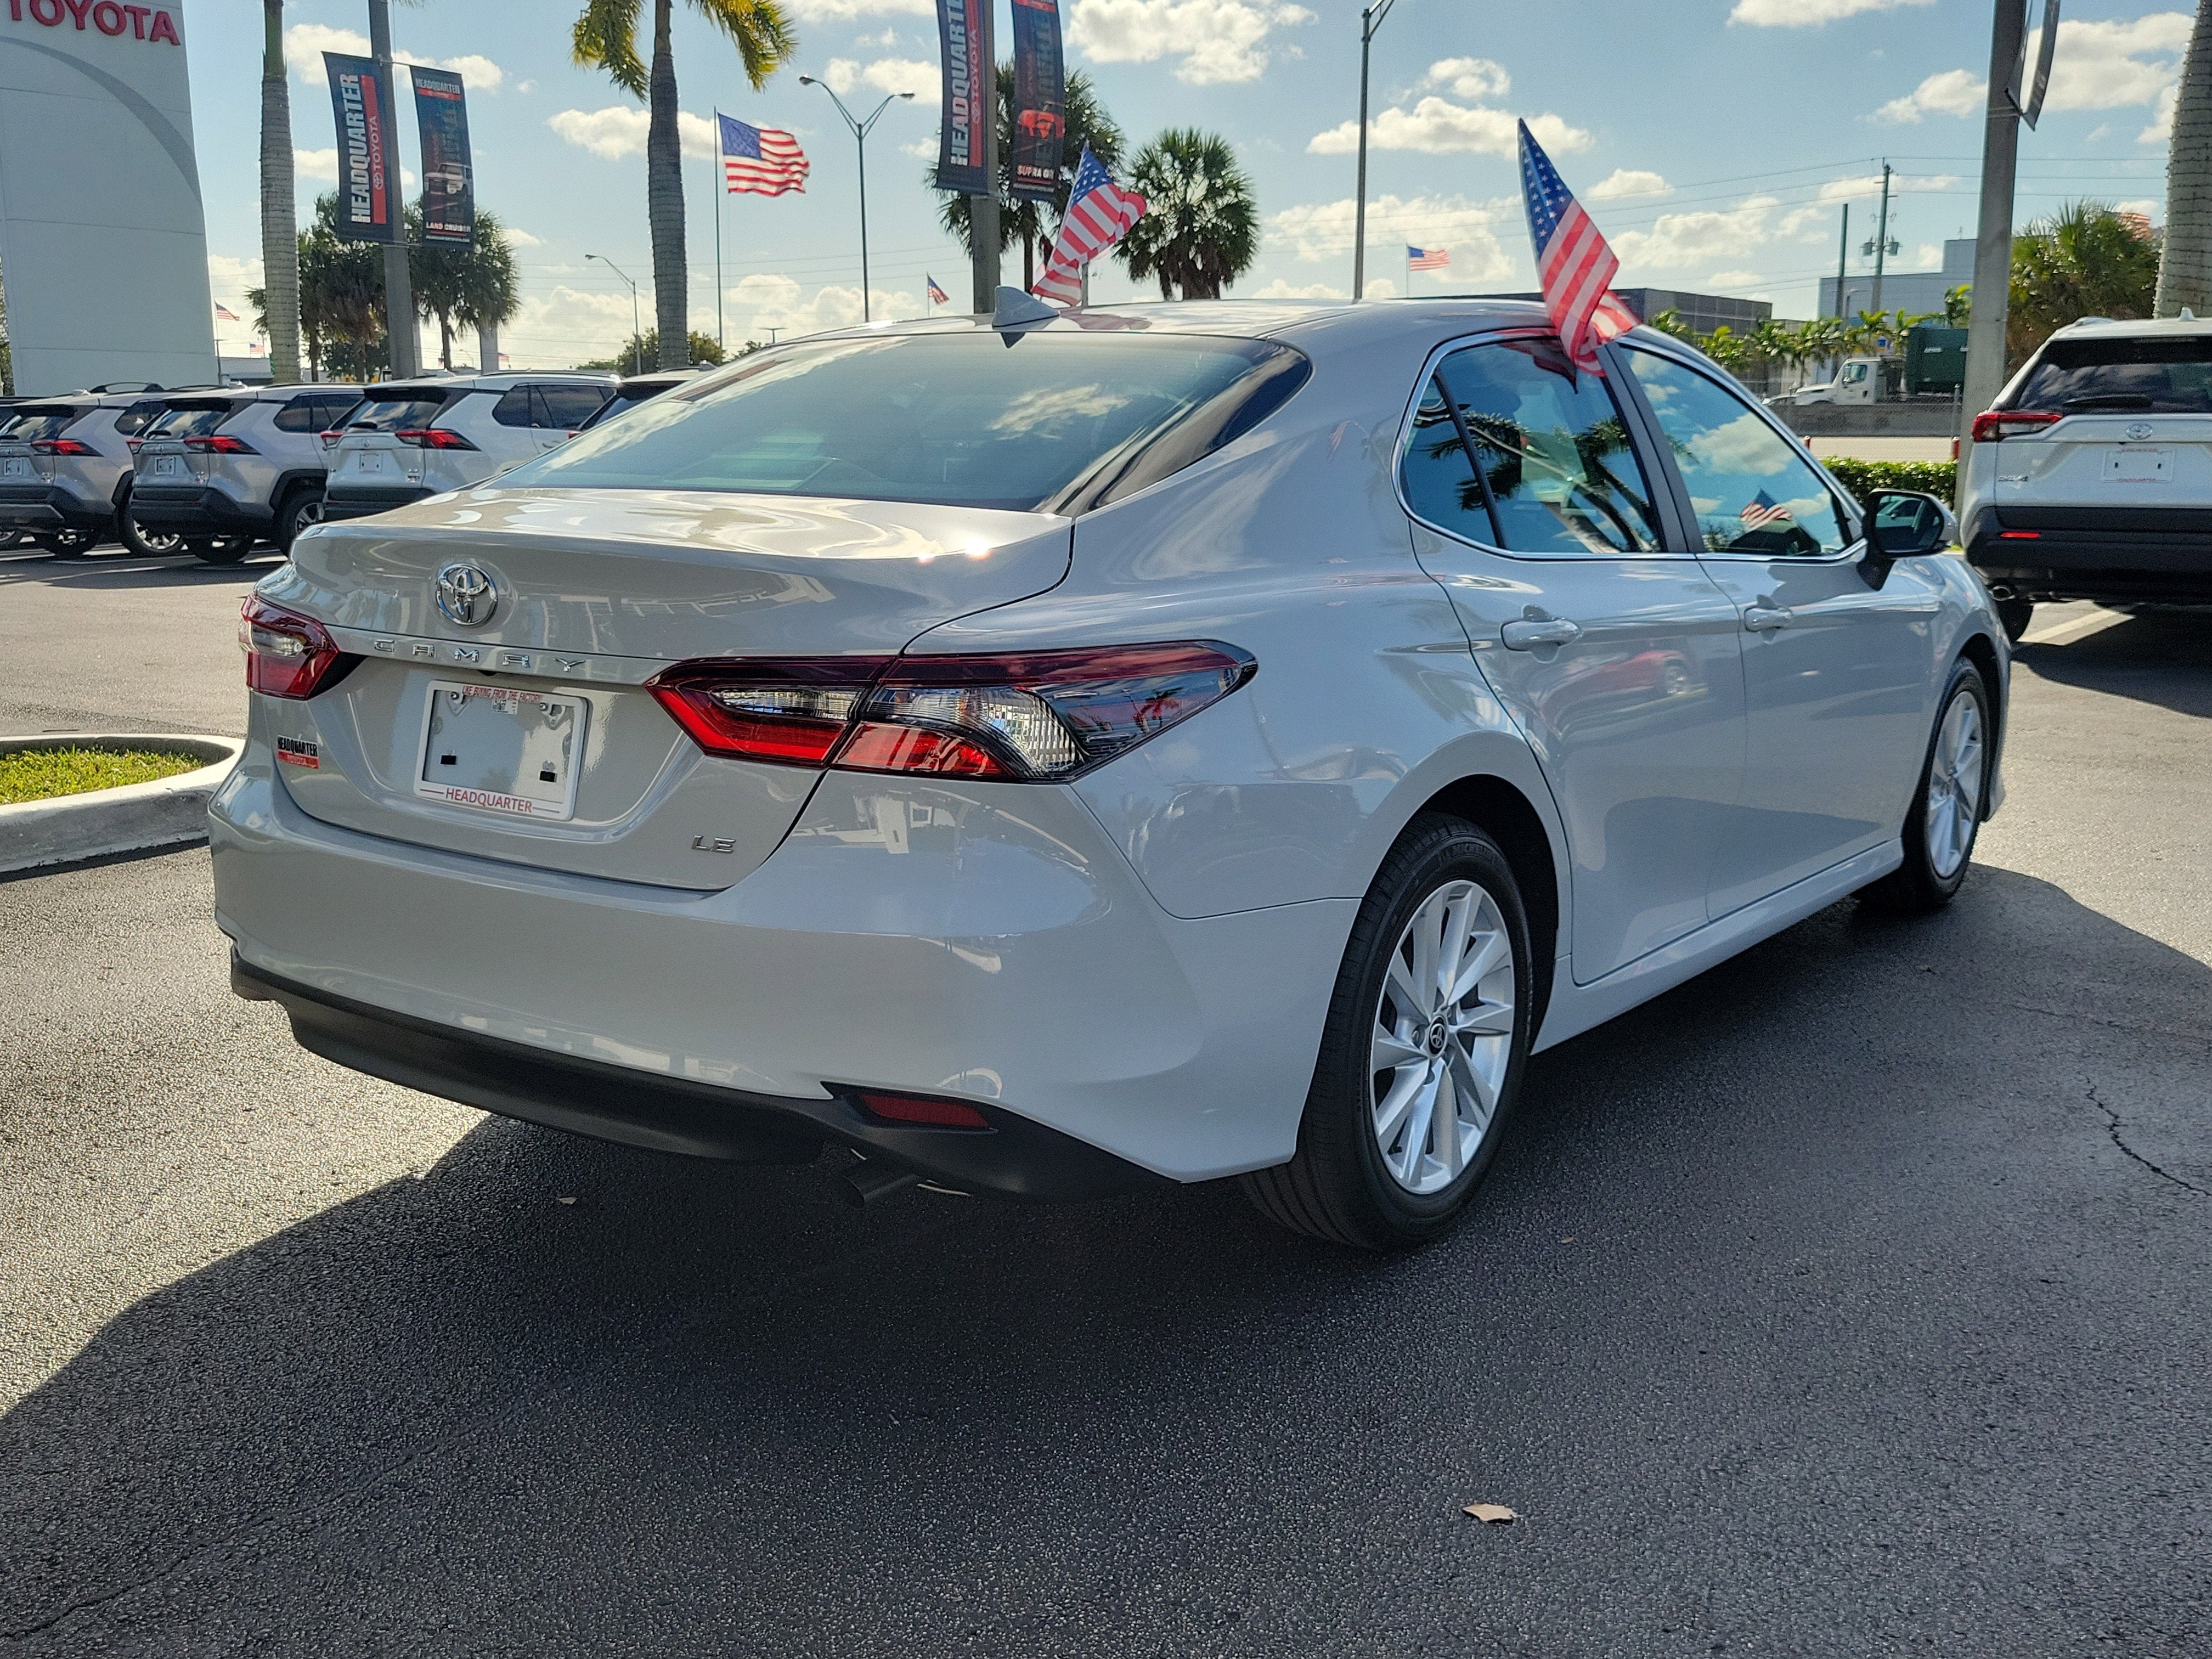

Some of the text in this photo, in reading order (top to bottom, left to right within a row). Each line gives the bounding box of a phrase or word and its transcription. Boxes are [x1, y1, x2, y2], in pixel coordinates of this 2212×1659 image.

[340, 73, 371, 224] HEADQUARTER
[369, 115, 382, 171] TOYOTA
[426, 221, 443, 230] LAND
[374, 639, 587, 673] CAMRY
[278, 736, 318, 757] HEADQUARTER
[445, 787, 532, 813] HEADQUARTER
[692, 834, 736, 854] LE
